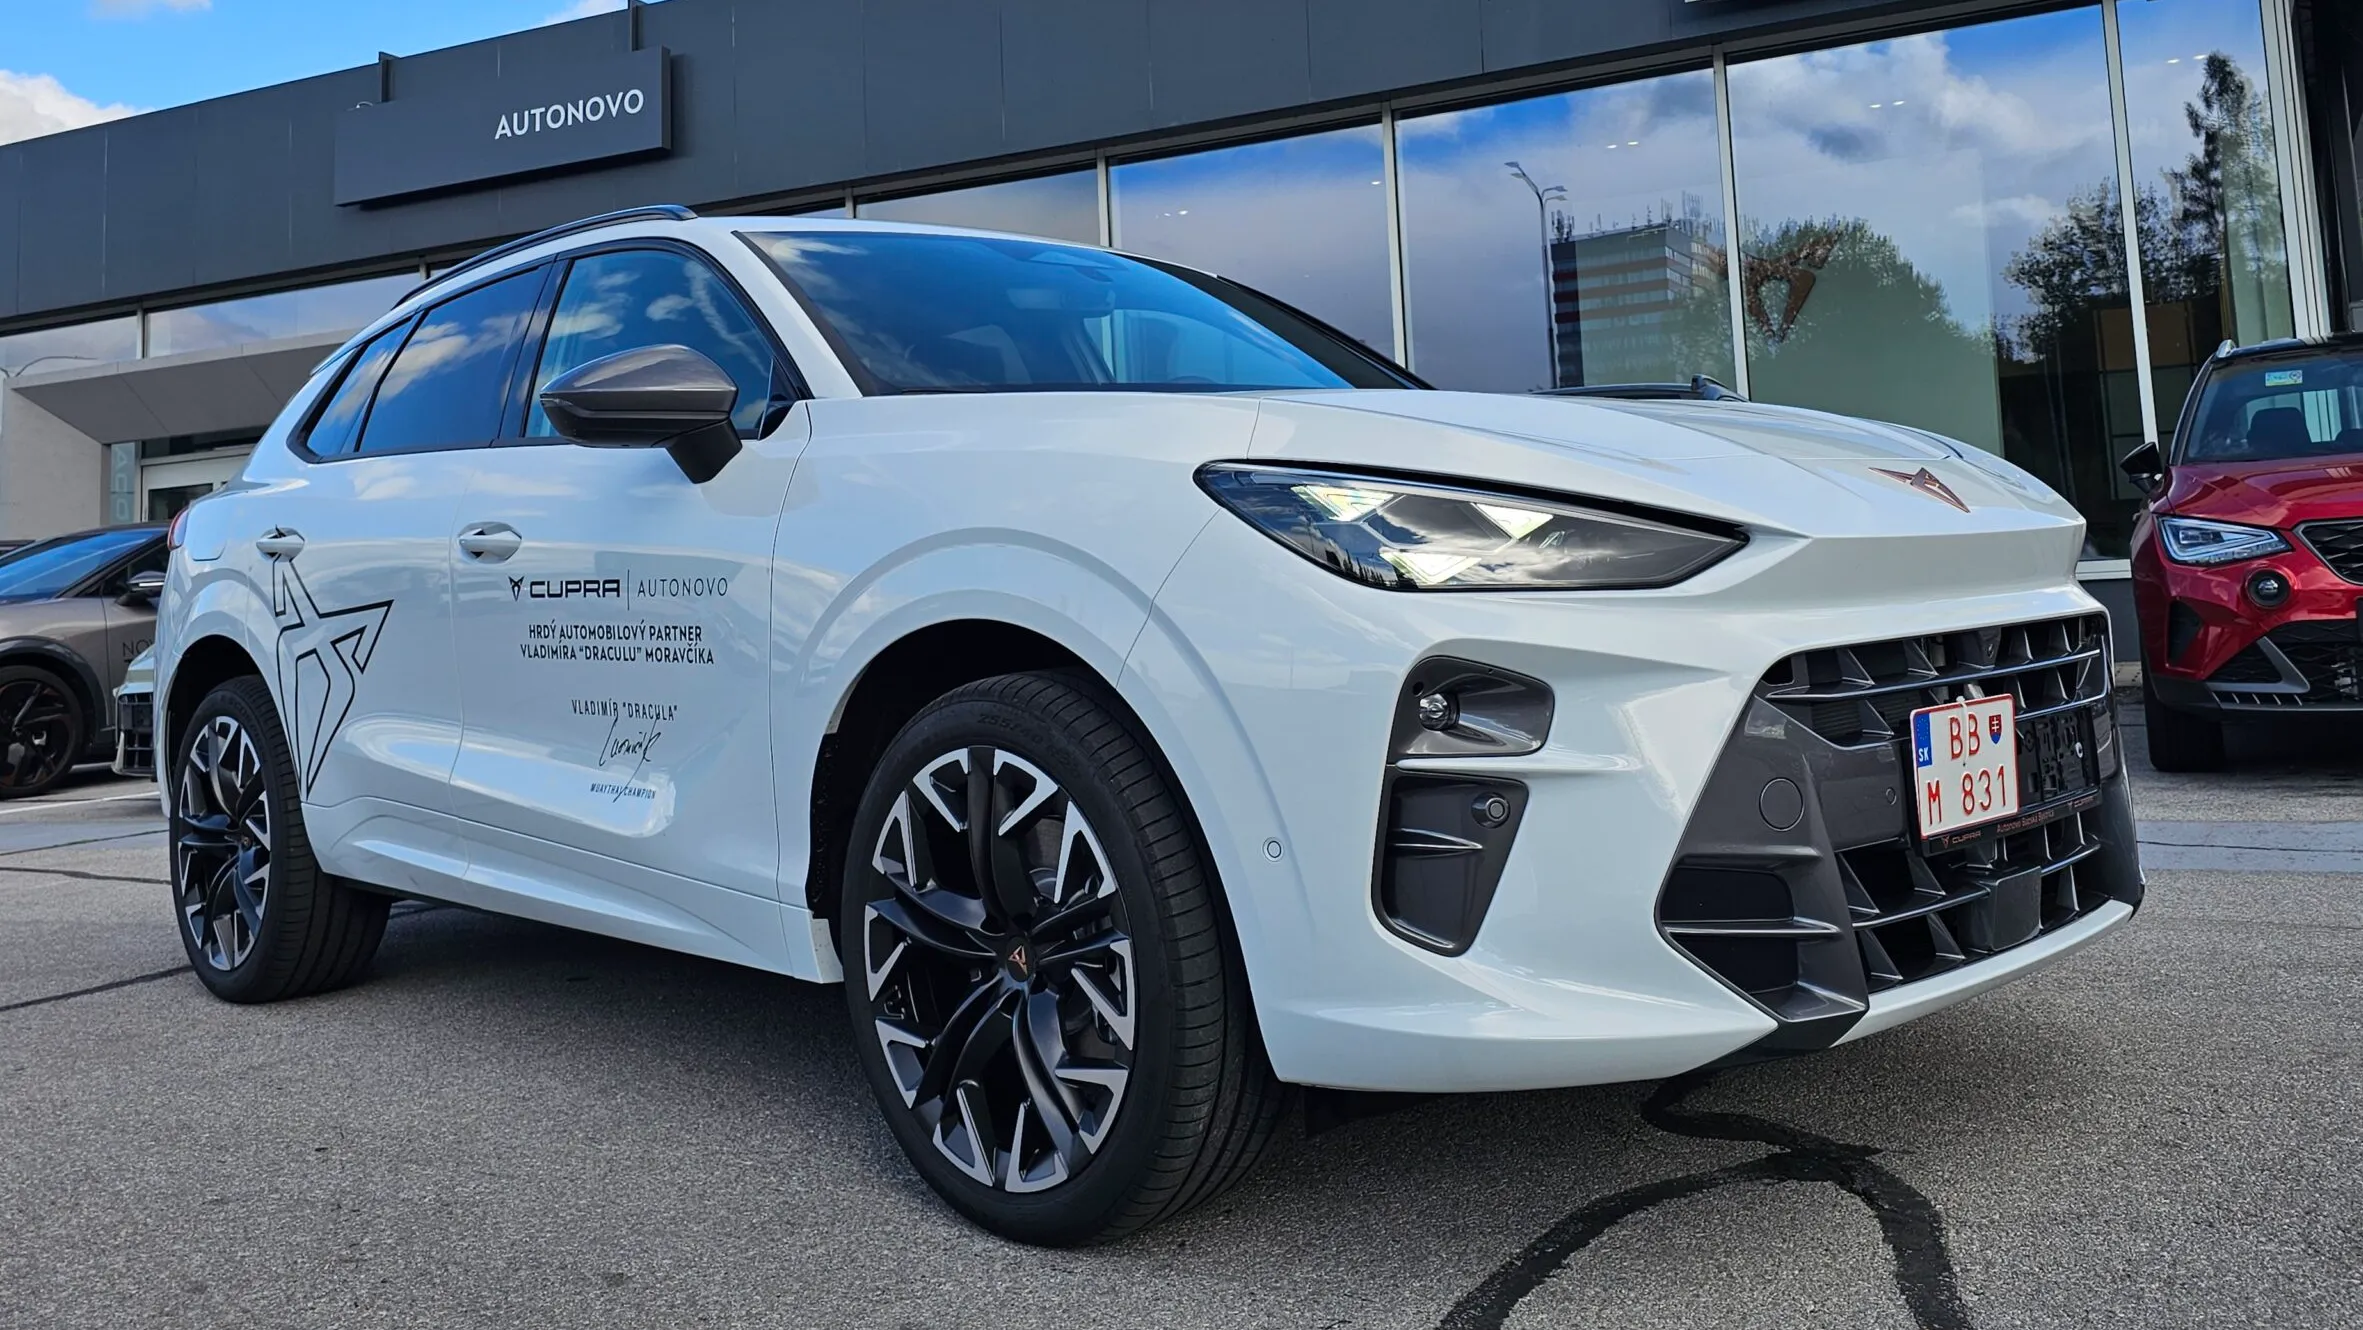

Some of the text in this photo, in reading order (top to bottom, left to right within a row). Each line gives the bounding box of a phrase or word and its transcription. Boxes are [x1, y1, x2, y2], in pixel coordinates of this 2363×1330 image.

[495, 89, 644, 140] AUTONOVO
[530, 577, 728, 598] CUPRA AUTONOVO
[528, 618, 702, 642] HRDÝ AUTOMOBILOVÝ PARTNER
[520, 640, 577, 660] VLADIMÍRA
[645, 642, 714, 665] MORAVČÍKA
[572, 698, 619, 717] VLADIMÍR
[1949, 713, 1980, 760] BB
[1918, 747, 1929, 762] SK
[1927, 765, 2006, 826] M 831
[1952, 830, 1982, 845] CUPRA
